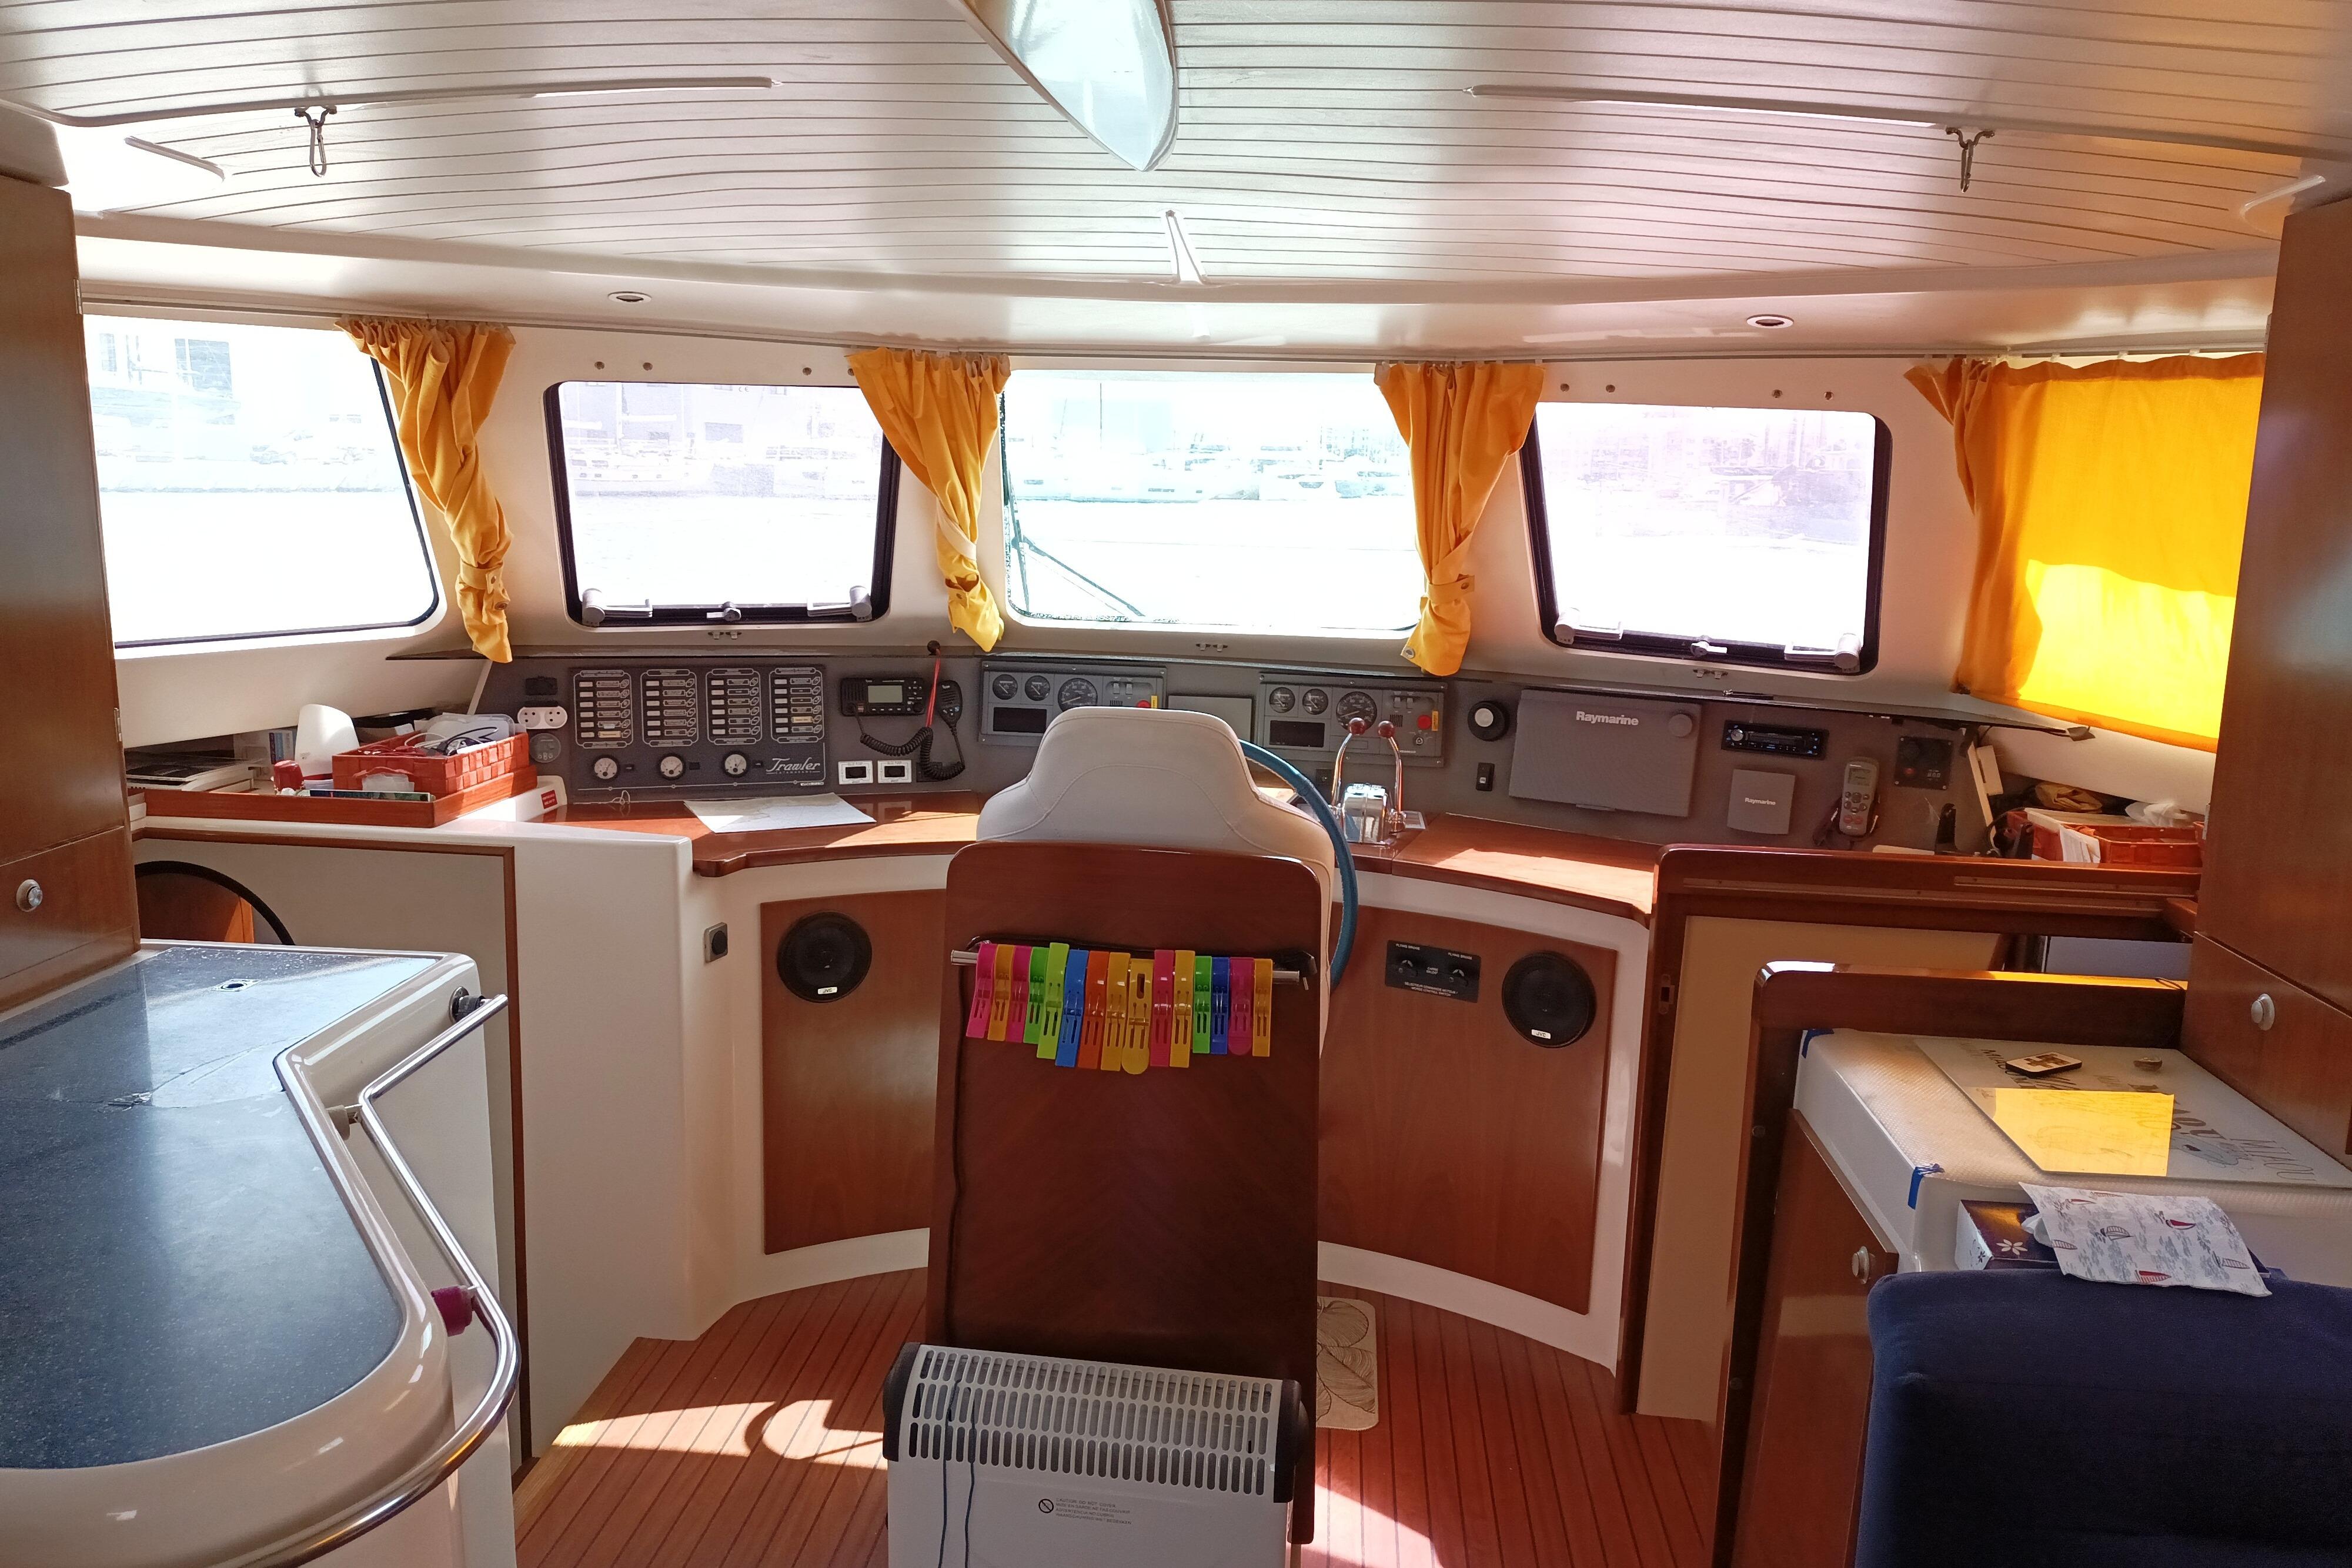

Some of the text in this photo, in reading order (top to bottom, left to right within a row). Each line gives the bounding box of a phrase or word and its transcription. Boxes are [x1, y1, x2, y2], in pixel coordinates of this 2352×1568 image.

[1576, 711, 1639, 726] Raymarine
[766, 757, 820, 772] Trawler
[1745, 797, 1776, 805] Raymarine
[2230, 1138, 2317, 1182] MIAOU
